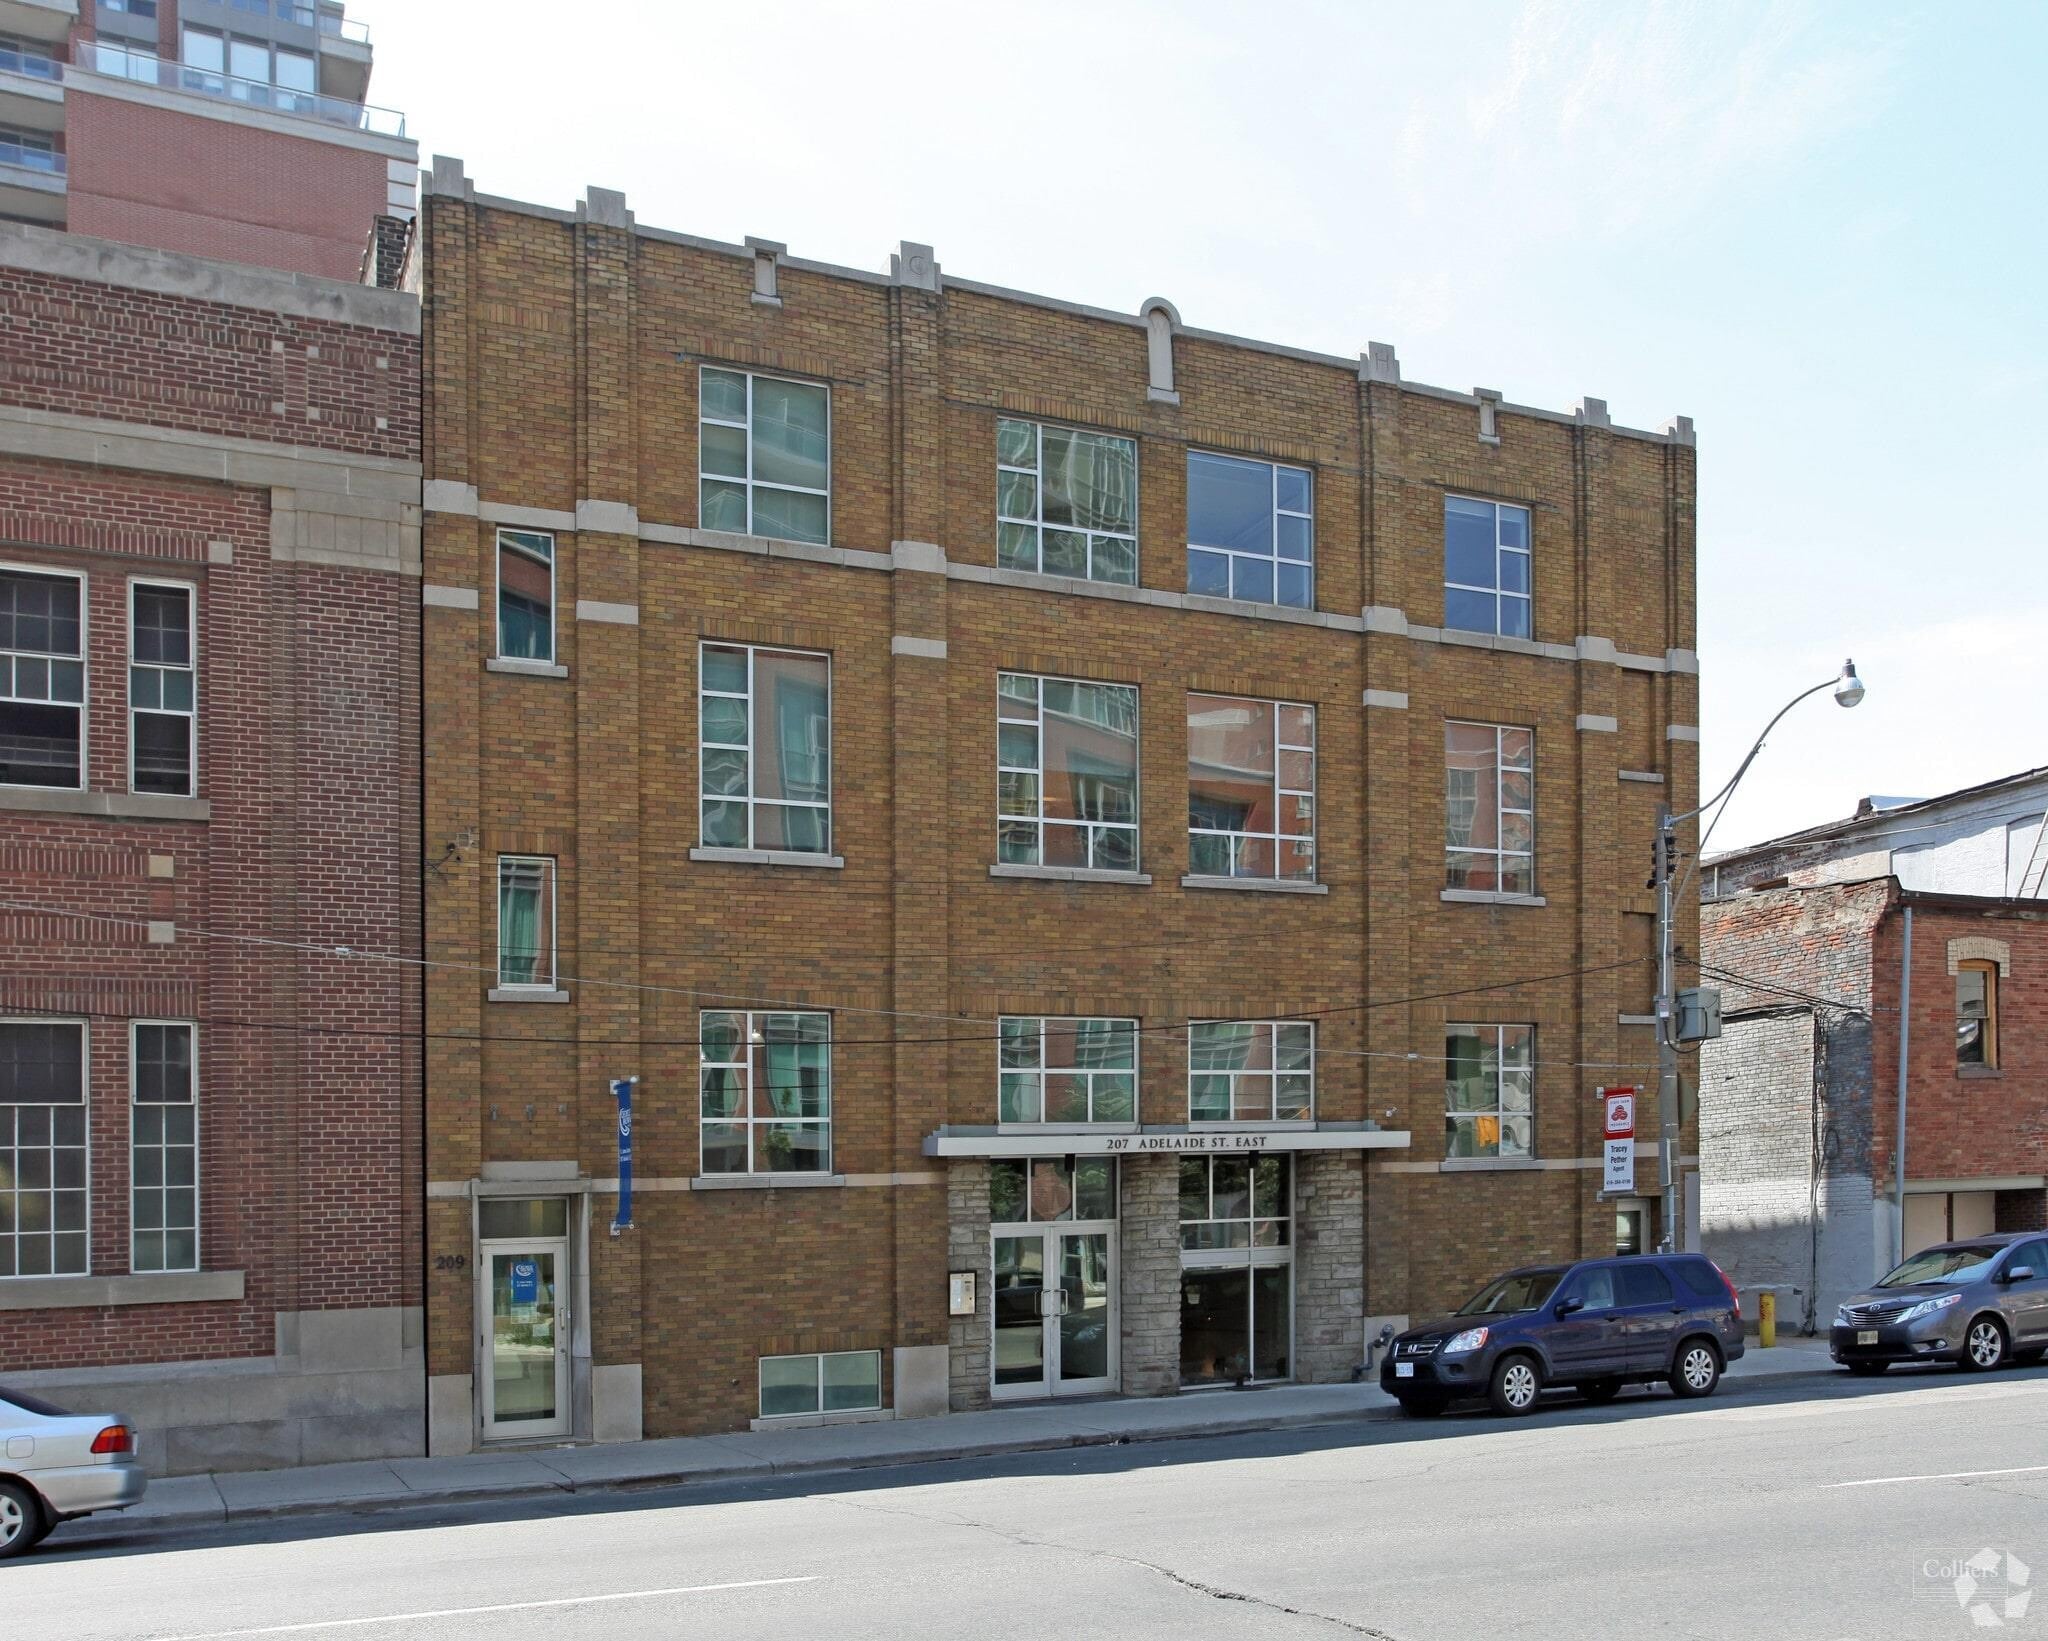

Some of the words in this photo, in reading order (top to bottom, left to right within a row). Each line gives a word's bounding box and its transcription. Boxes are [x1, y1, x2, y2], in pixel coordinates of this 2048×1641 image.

[1107, 1139, 1129, 1149] 207
[1139, 1138, 1206, 1149] ADELAIDE
[1211, 1137, 1230, 1148] ST.
[1235, 1136, 1267, 1147] EAST
[1610, 1145, 1627, 1153] Tracey
[435, 1255, 465, 1270] 209
